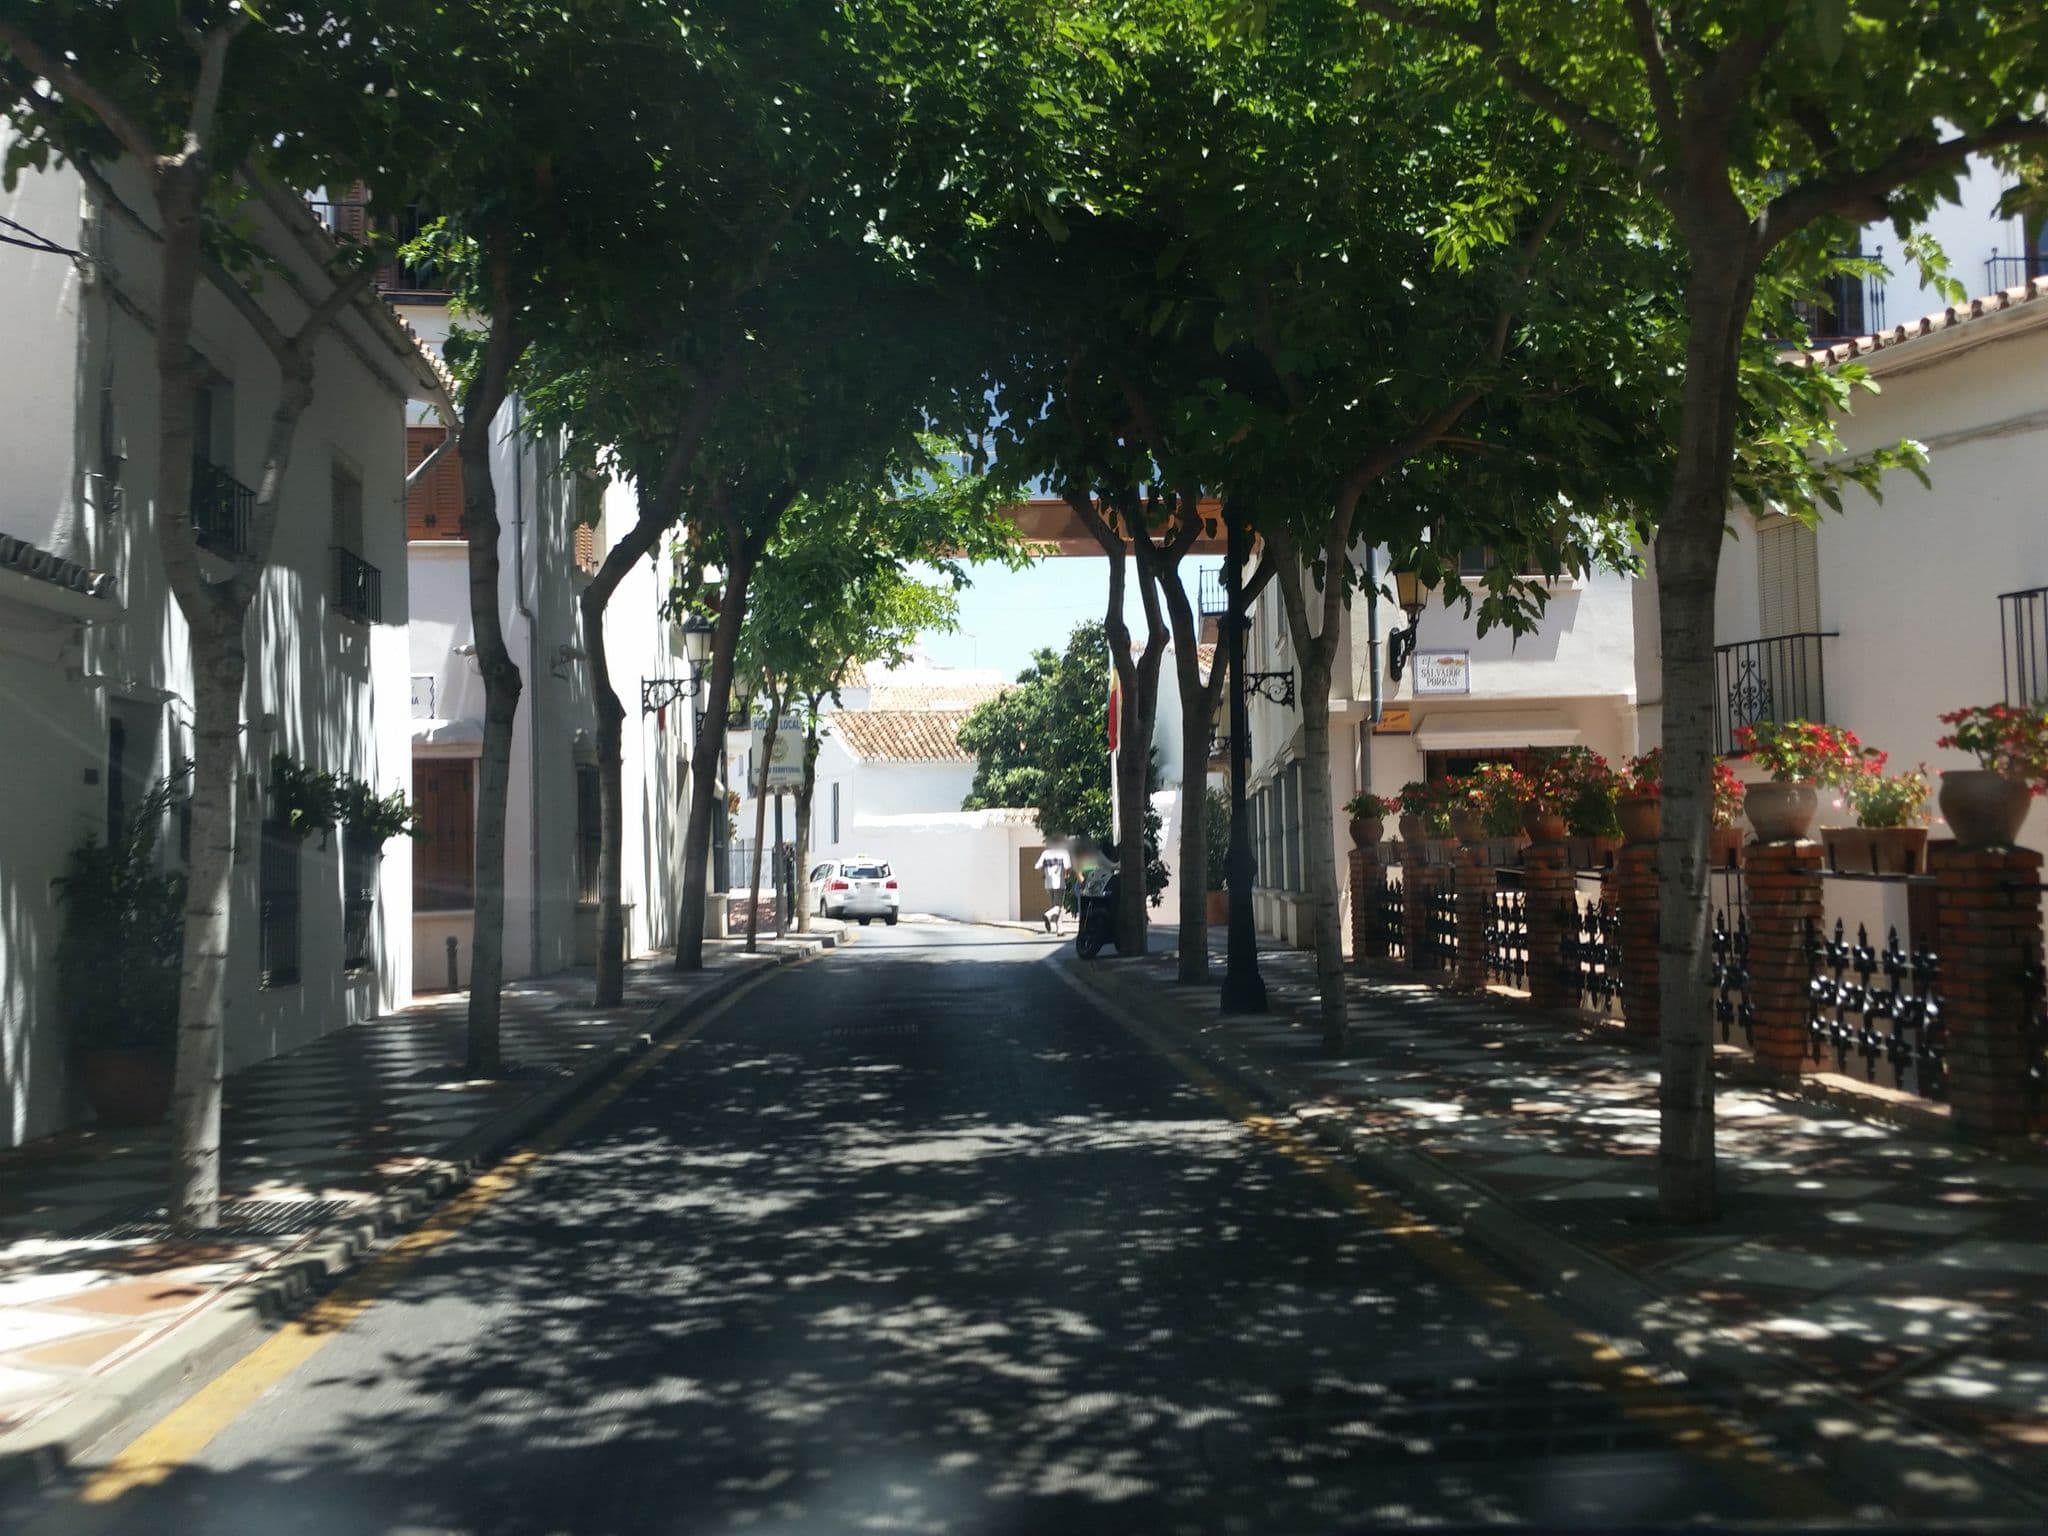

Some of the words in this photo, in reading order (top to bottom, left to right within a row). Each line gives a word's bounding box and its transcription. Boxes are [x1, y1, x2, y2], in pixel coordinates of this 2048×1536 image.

[1421, 668, 1461, 678] SALVADOR
[1427, 677, 1458, 687] PORRAS
[780, 719, 800, 731] LOCAL
